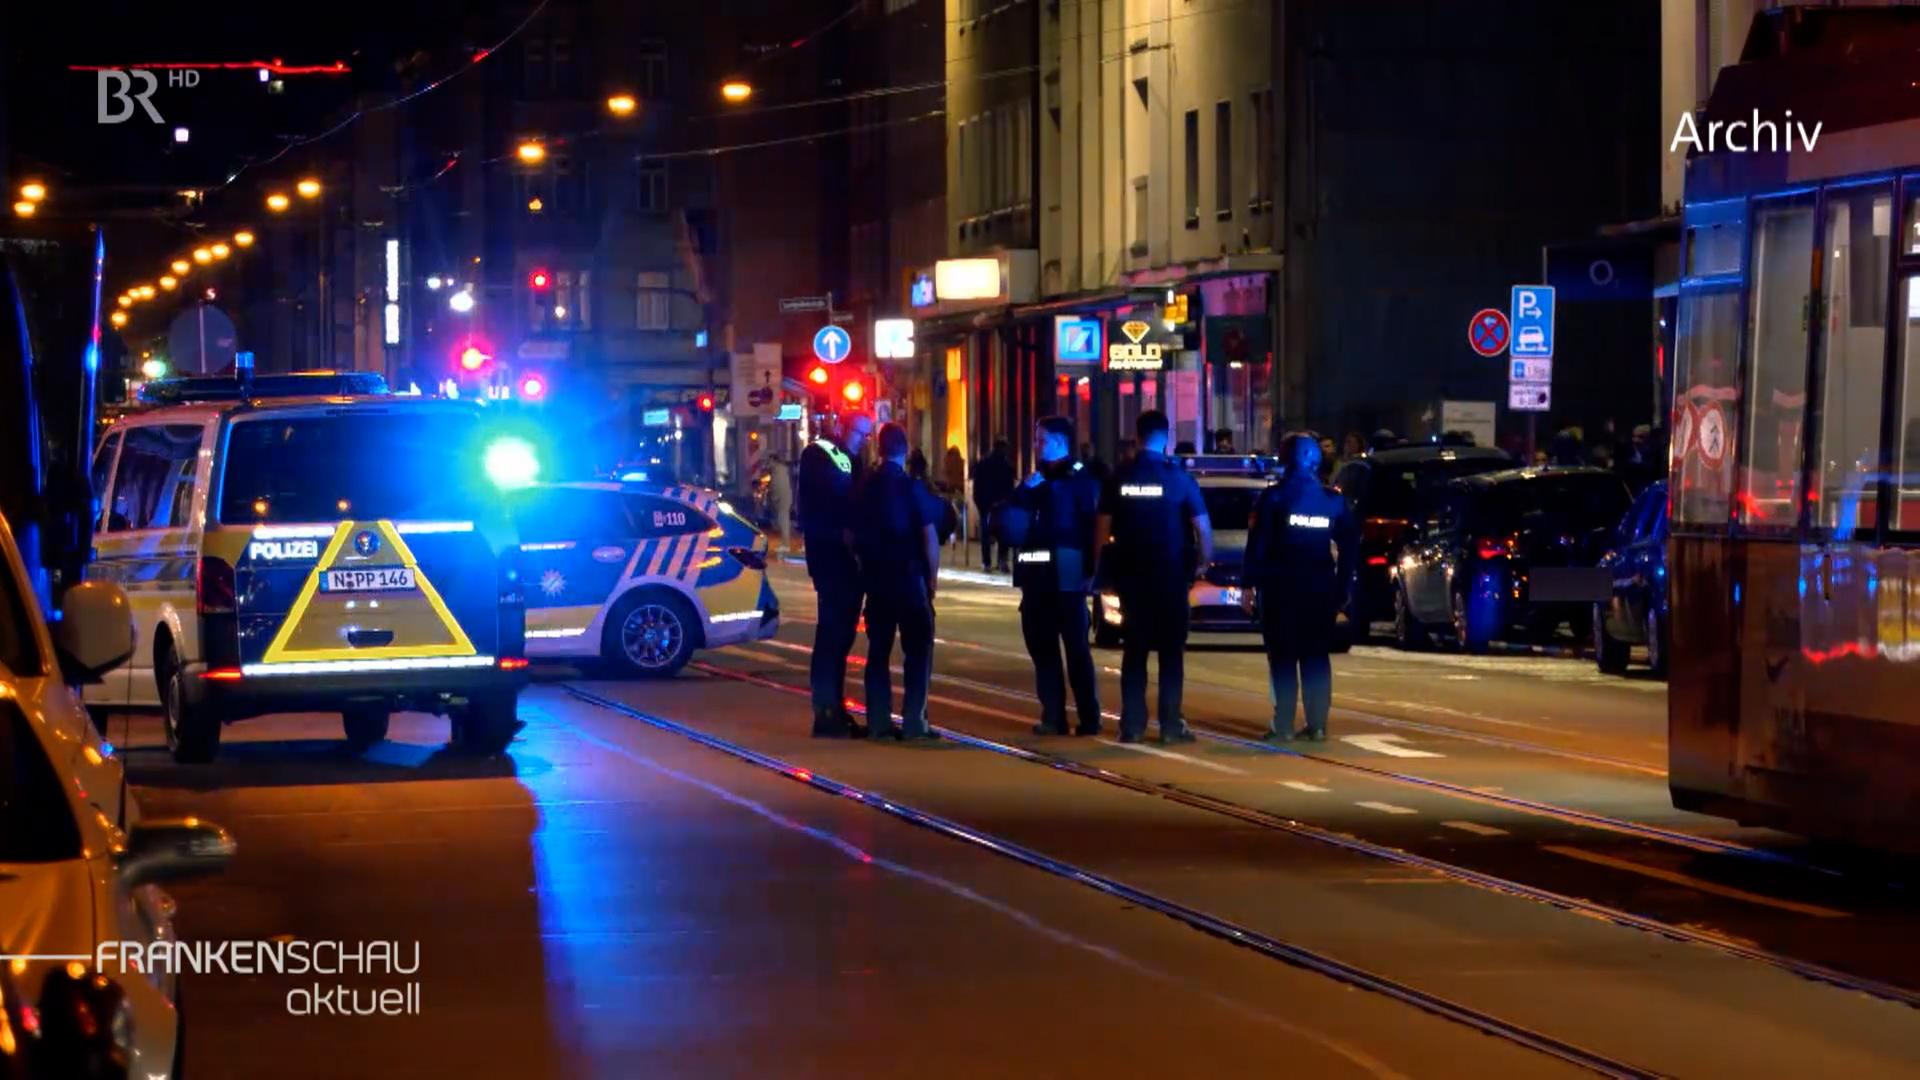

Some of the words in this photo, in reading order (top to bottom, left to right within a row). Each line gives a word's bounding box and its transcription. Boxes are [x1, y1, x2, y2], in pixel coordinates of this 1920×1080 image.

[1121, 486, 1163, 496] POLIZEI
[250, 540, 318, 560] POLIZEI
[379, 570, 408, 587] 146
